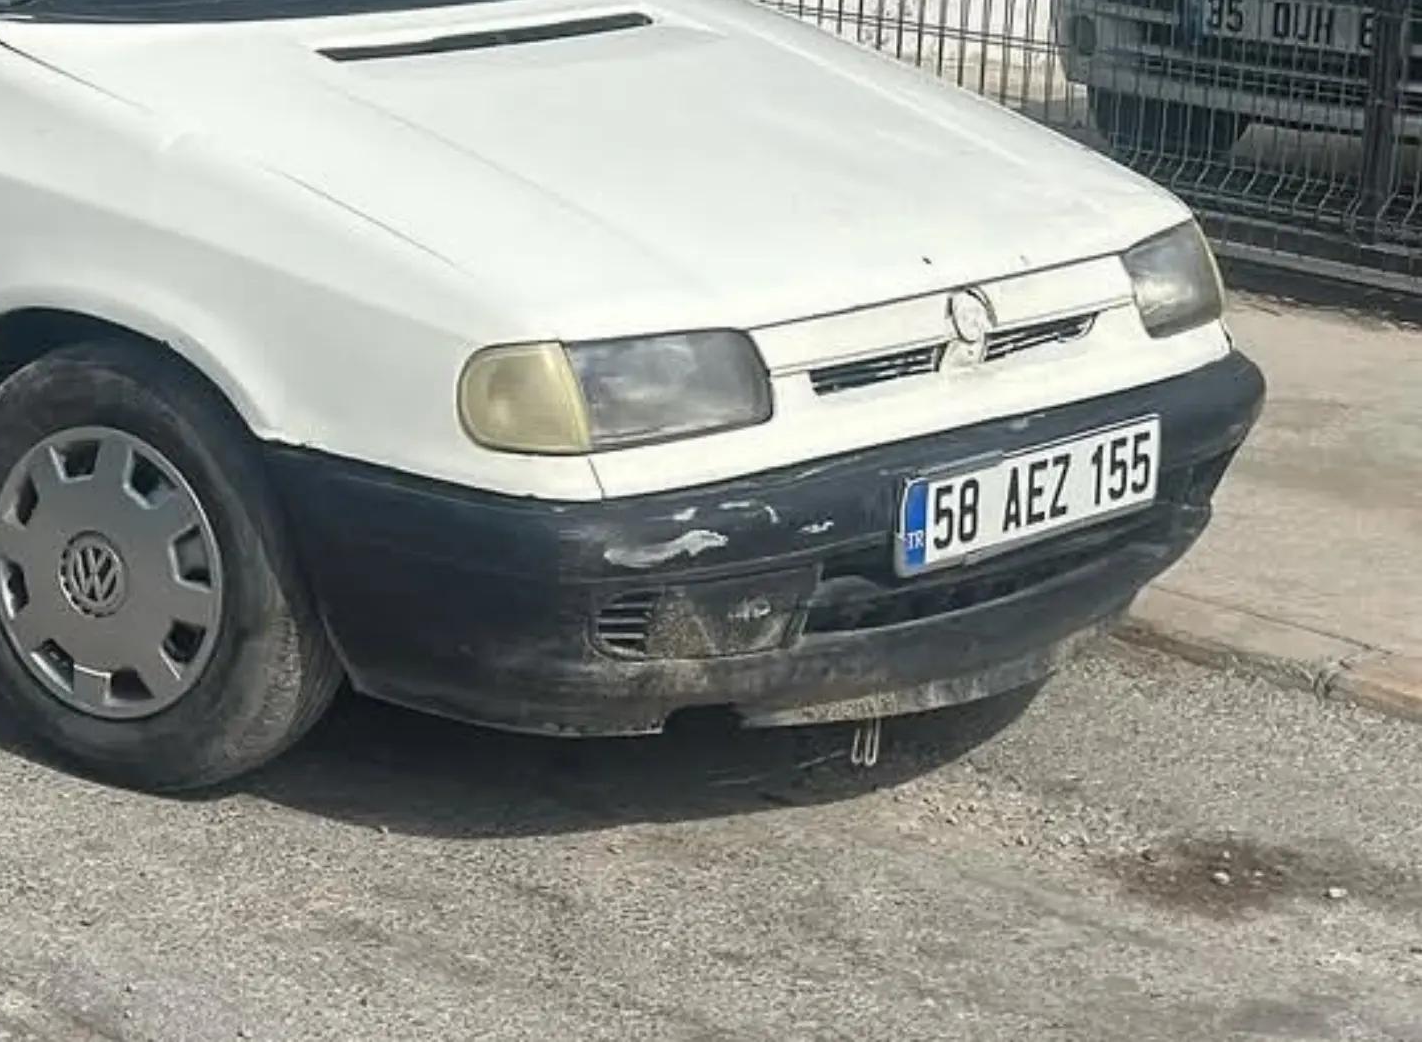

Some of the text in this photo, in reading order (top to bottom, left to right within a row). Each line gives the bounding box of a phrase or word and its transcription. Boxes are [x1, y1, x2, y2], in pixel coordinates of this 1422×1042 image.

[932, 430, 1152, 550] 58 AEZ 155
[906, 529, 924, 550] TR
